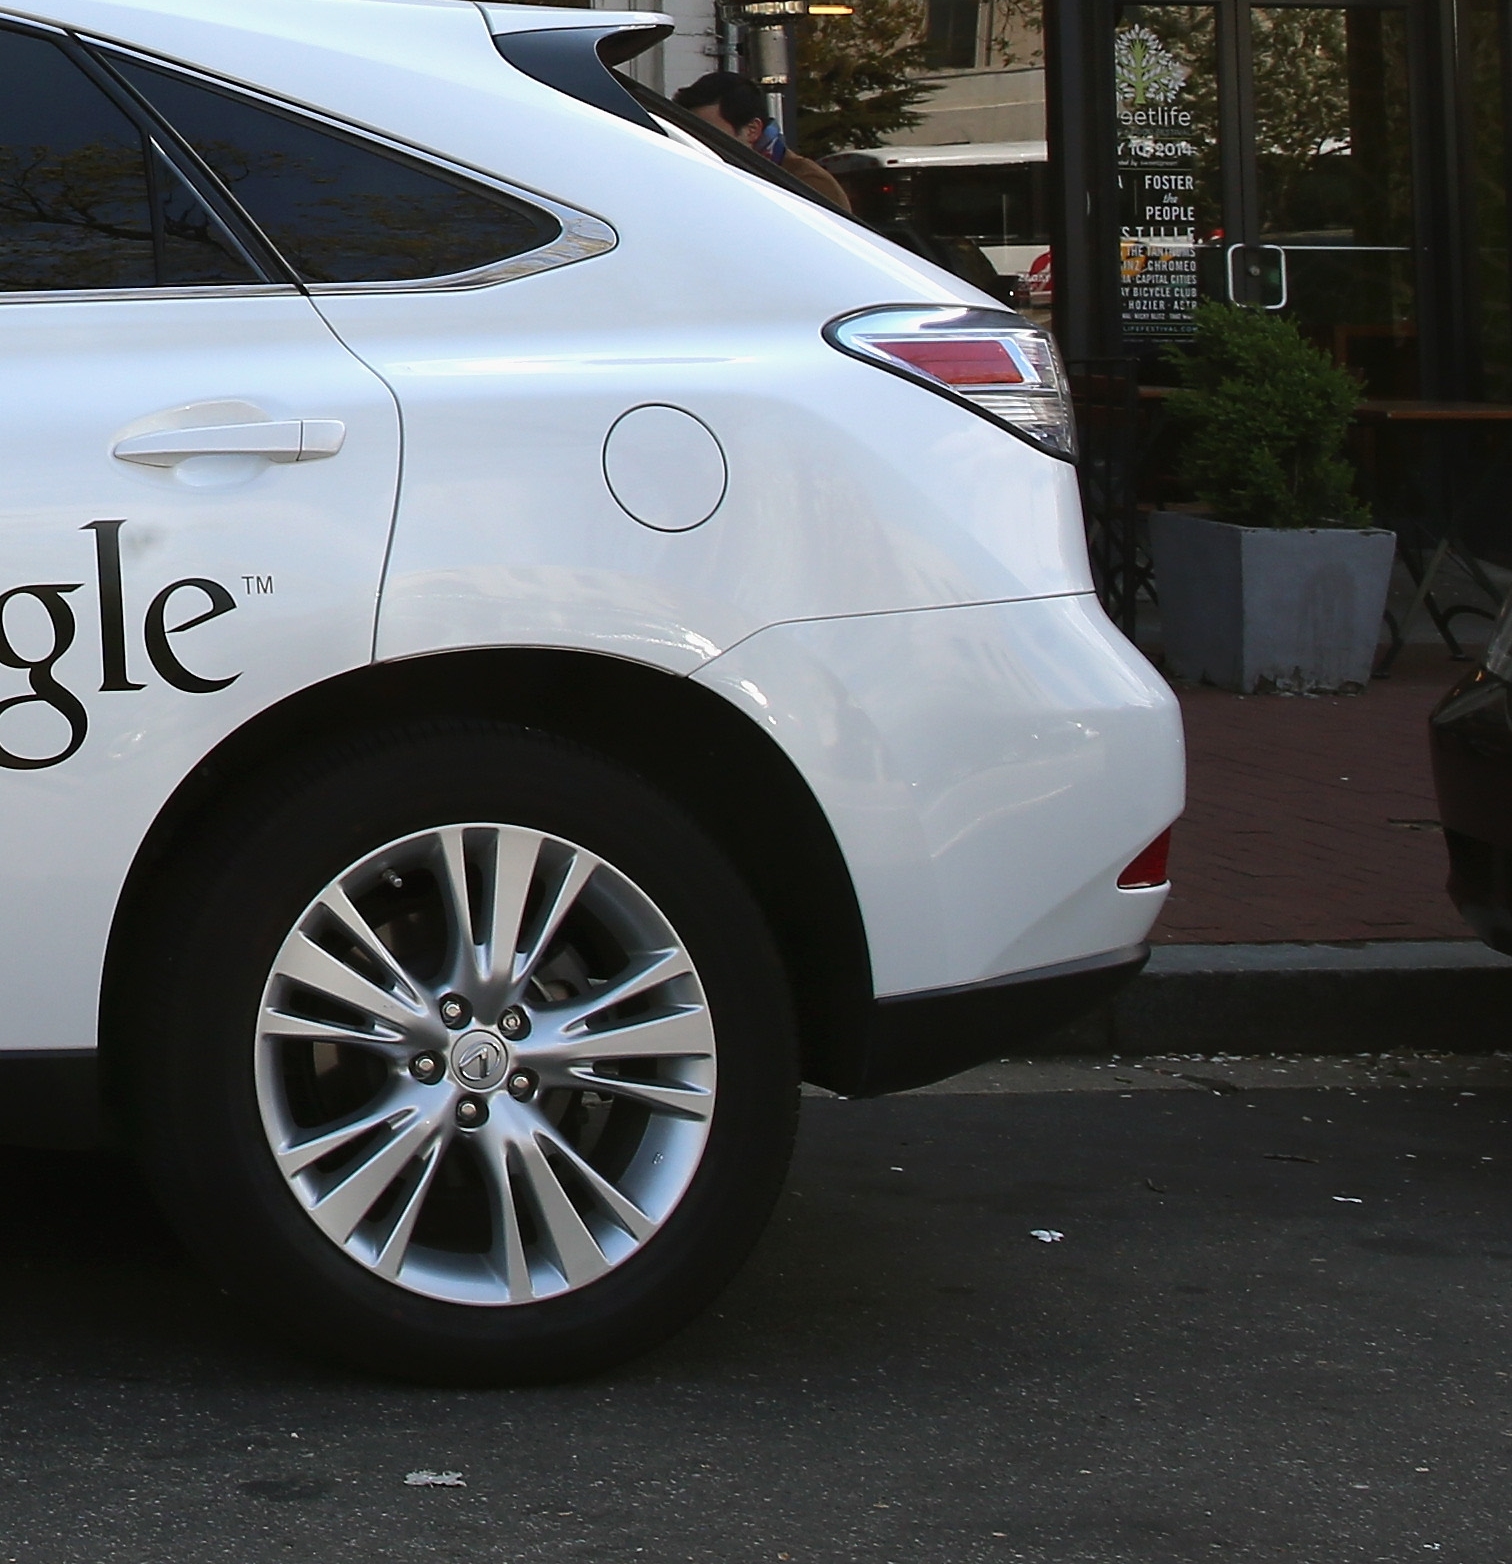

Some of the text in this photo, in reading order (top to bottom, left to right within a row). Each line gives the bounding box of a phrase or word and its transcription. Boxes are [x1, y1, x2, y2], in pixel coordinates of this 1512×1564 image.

[1144, 175, 1194, 190] FOSTER
[1162, 193, 1179, 204] the
[1145, 206, 1195, 221] PEOPLE
[1147, 261, 1197, 272] CHROMEO
[1136, 274, 1168, 284] CAPITAL
[1170, 274, 1197, 284] CITIES
[1133, 287, 1171, 297] BICYCLE
[1174, 287, 1197, 297] CLUB
[1128, 301, 1165, 310] HOZIER
[241, 576, 275, 595] TM
